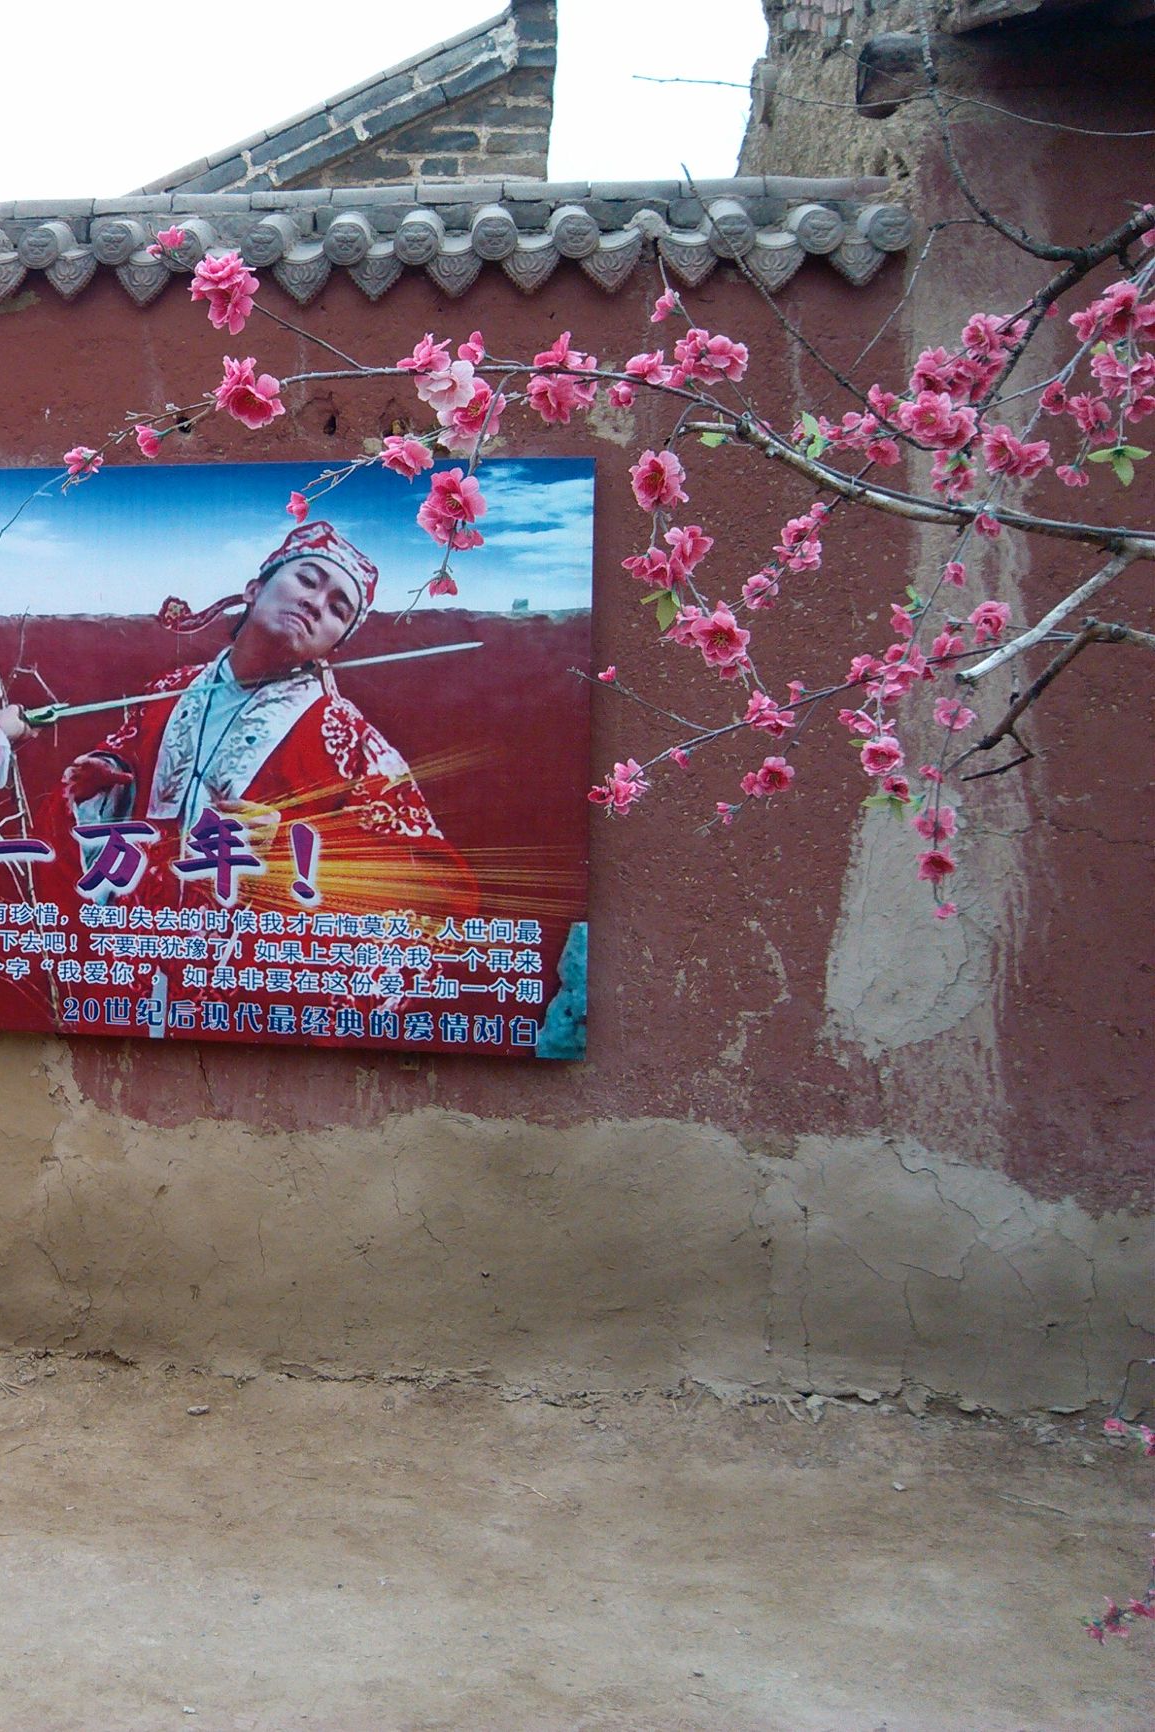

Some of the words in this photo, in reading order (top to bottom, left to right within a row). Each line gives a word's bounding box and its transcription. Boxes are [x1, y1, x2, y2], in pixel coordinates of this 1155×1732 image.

[62, 996, 539, 1047] 20世纪后现代最经典的爱情对白
